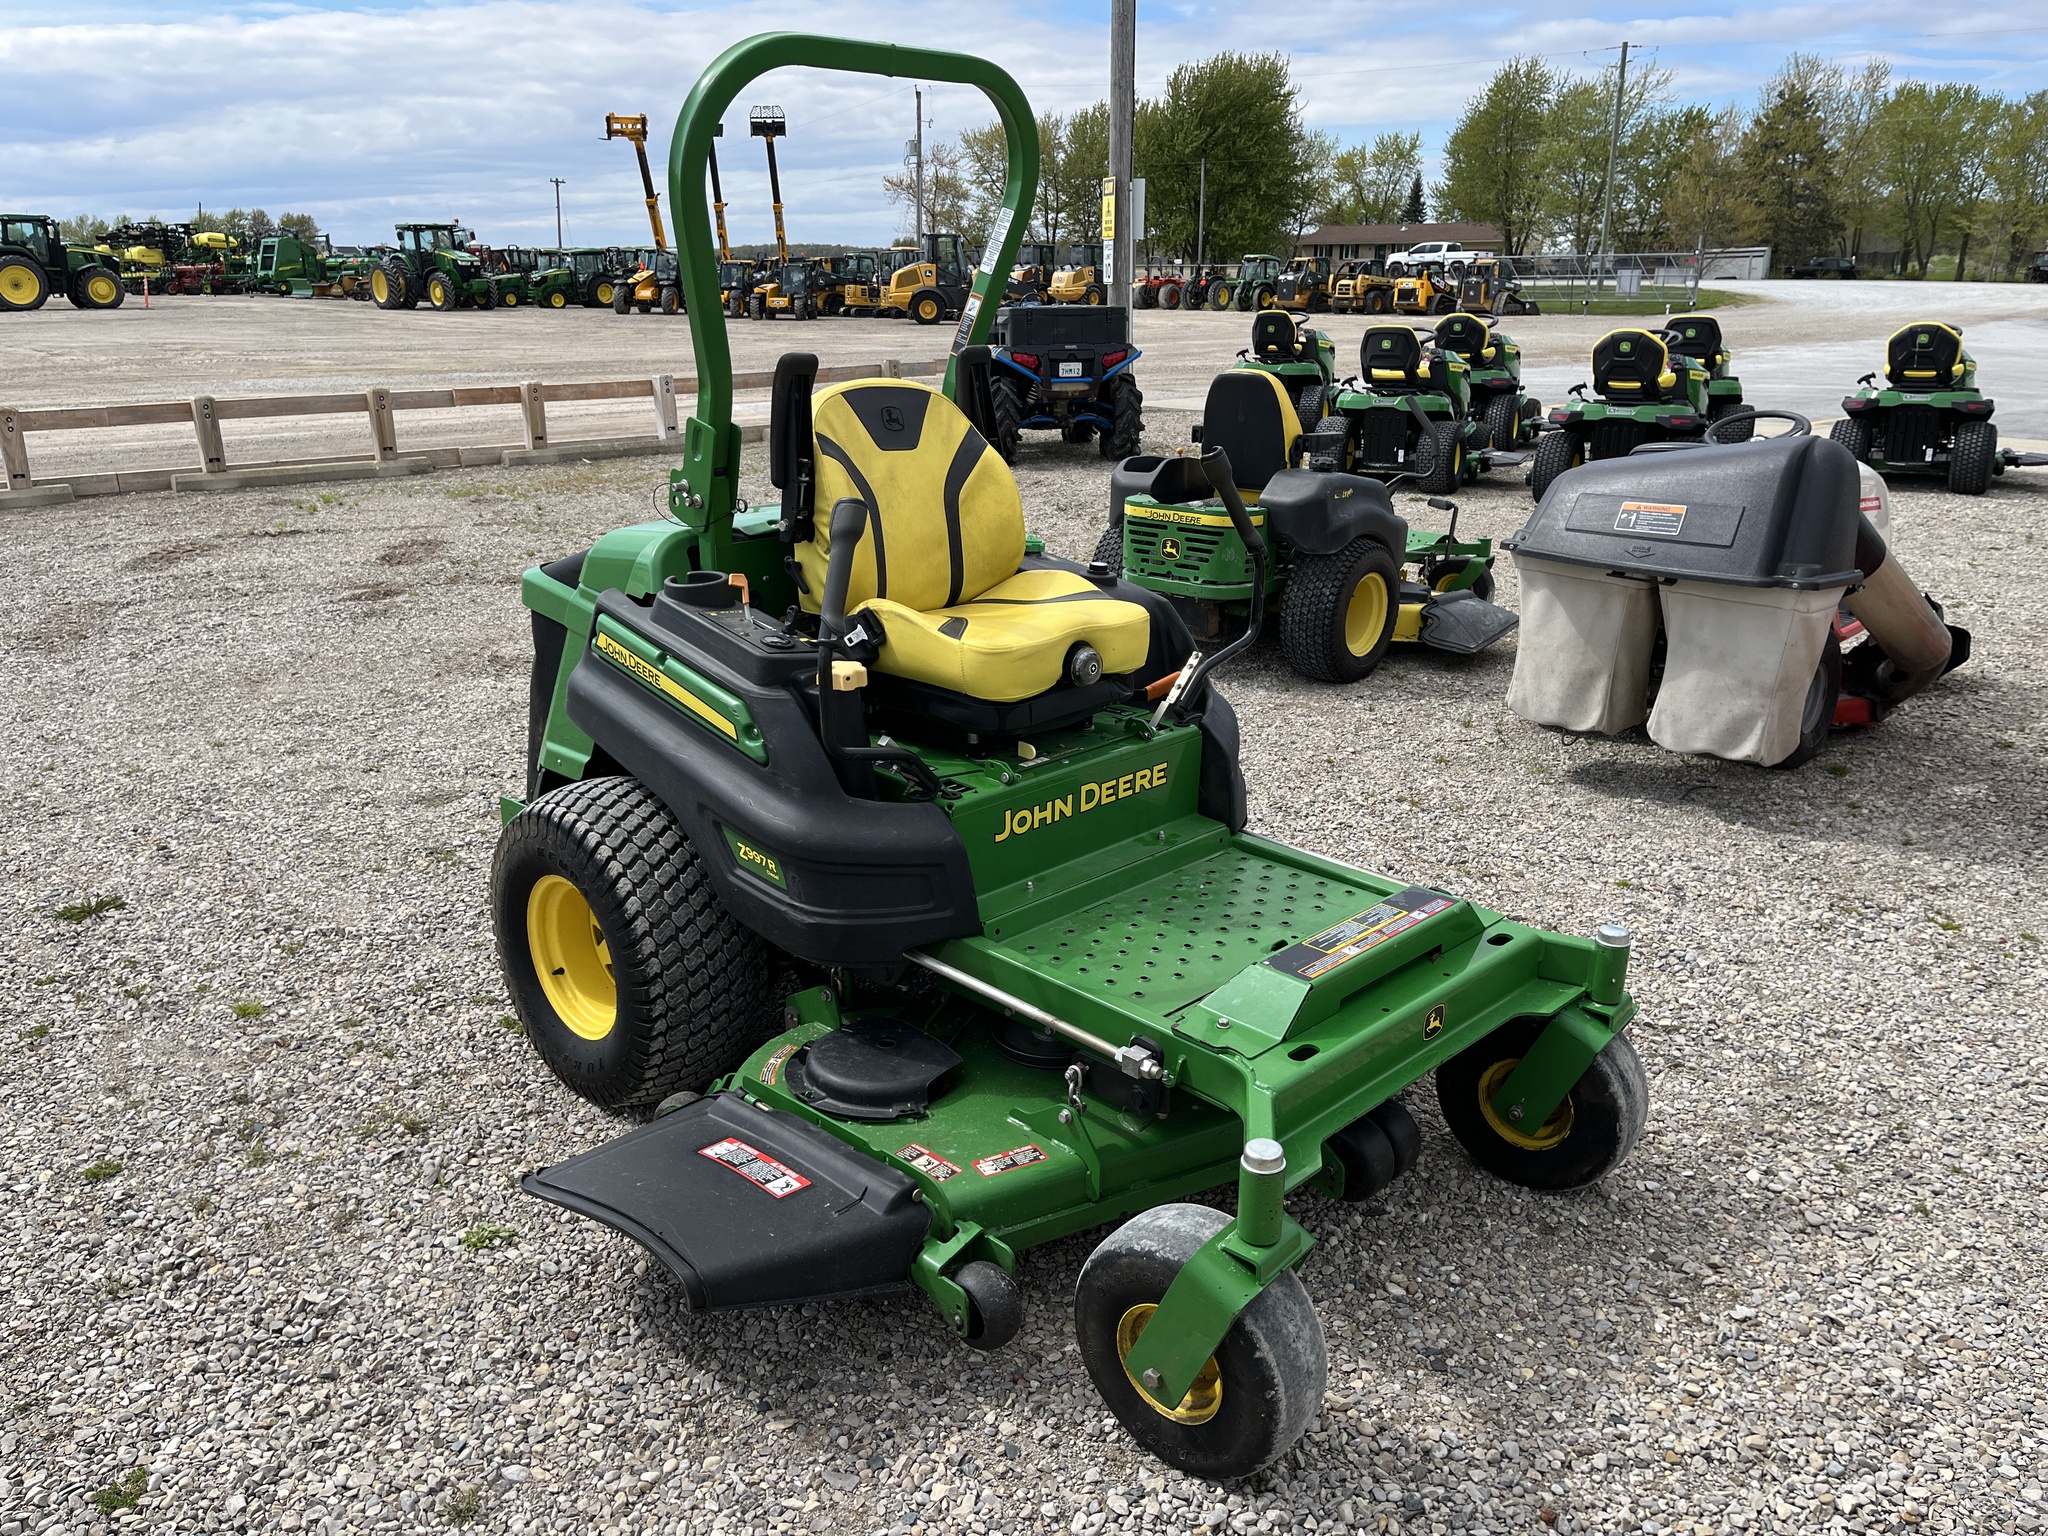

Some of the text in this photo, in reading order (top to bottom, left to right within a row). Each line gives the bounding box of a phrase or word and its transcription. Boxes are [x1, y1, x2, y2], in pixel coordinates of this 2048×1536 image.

[1105, 263, 1111, 279] 10
[1430, 275, 1445, 288] JCB
[1147, 509, 1202, 525] JOHN DEERE
[603, 638, 661, 688] JOHN DEERE
[994, 761, 1168, 843] JOHN DEERE
